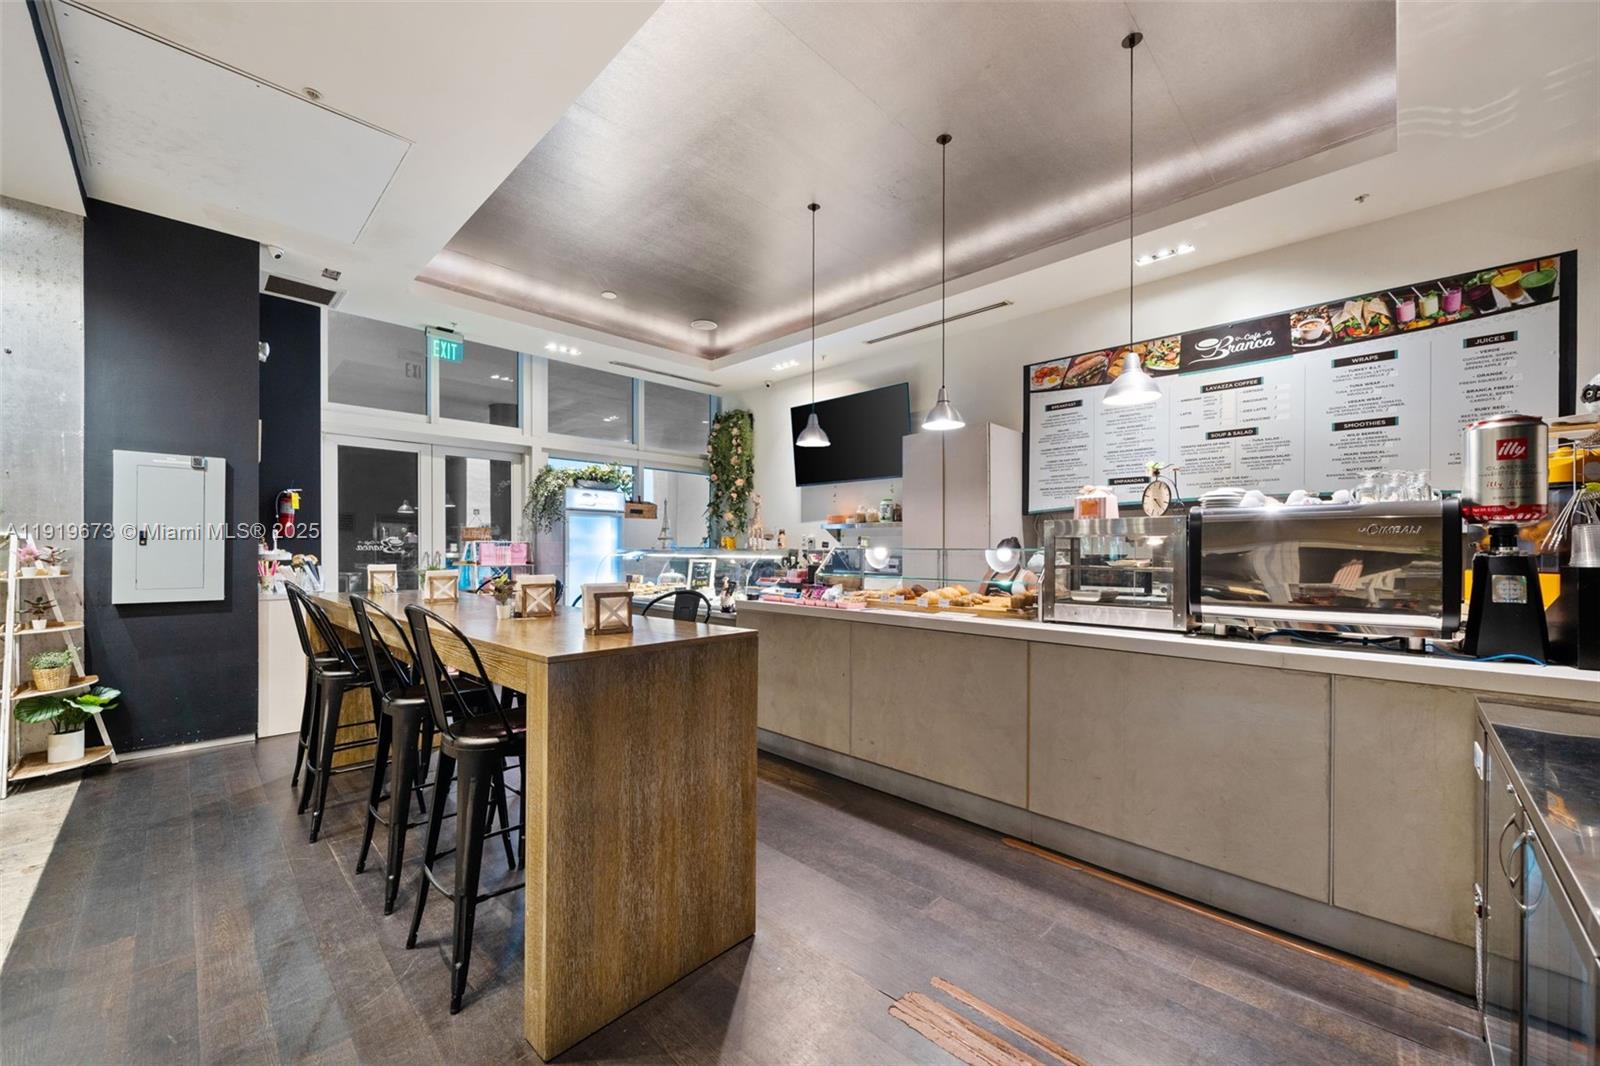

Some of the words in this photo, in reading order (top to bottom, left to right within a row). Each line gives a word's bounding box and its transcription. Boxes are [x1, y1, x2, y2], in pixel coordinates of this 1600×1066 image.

[1475, 334, 1506, 344] JUICES
[433, 340, 458, 360] EXIT
[1194, 335, 1276, 361] Branca
[1352, 355, 1378, 363] WRAPS
[406, 362, 421, 379] EXI
[1205, 383, 1232, 392] LAVAZZA
[1234, 379, 1258, 387] COFFEE
[1344, 420, 1386, 429] SMOOTHIES
[1498, 441, 1526, 458] illy
